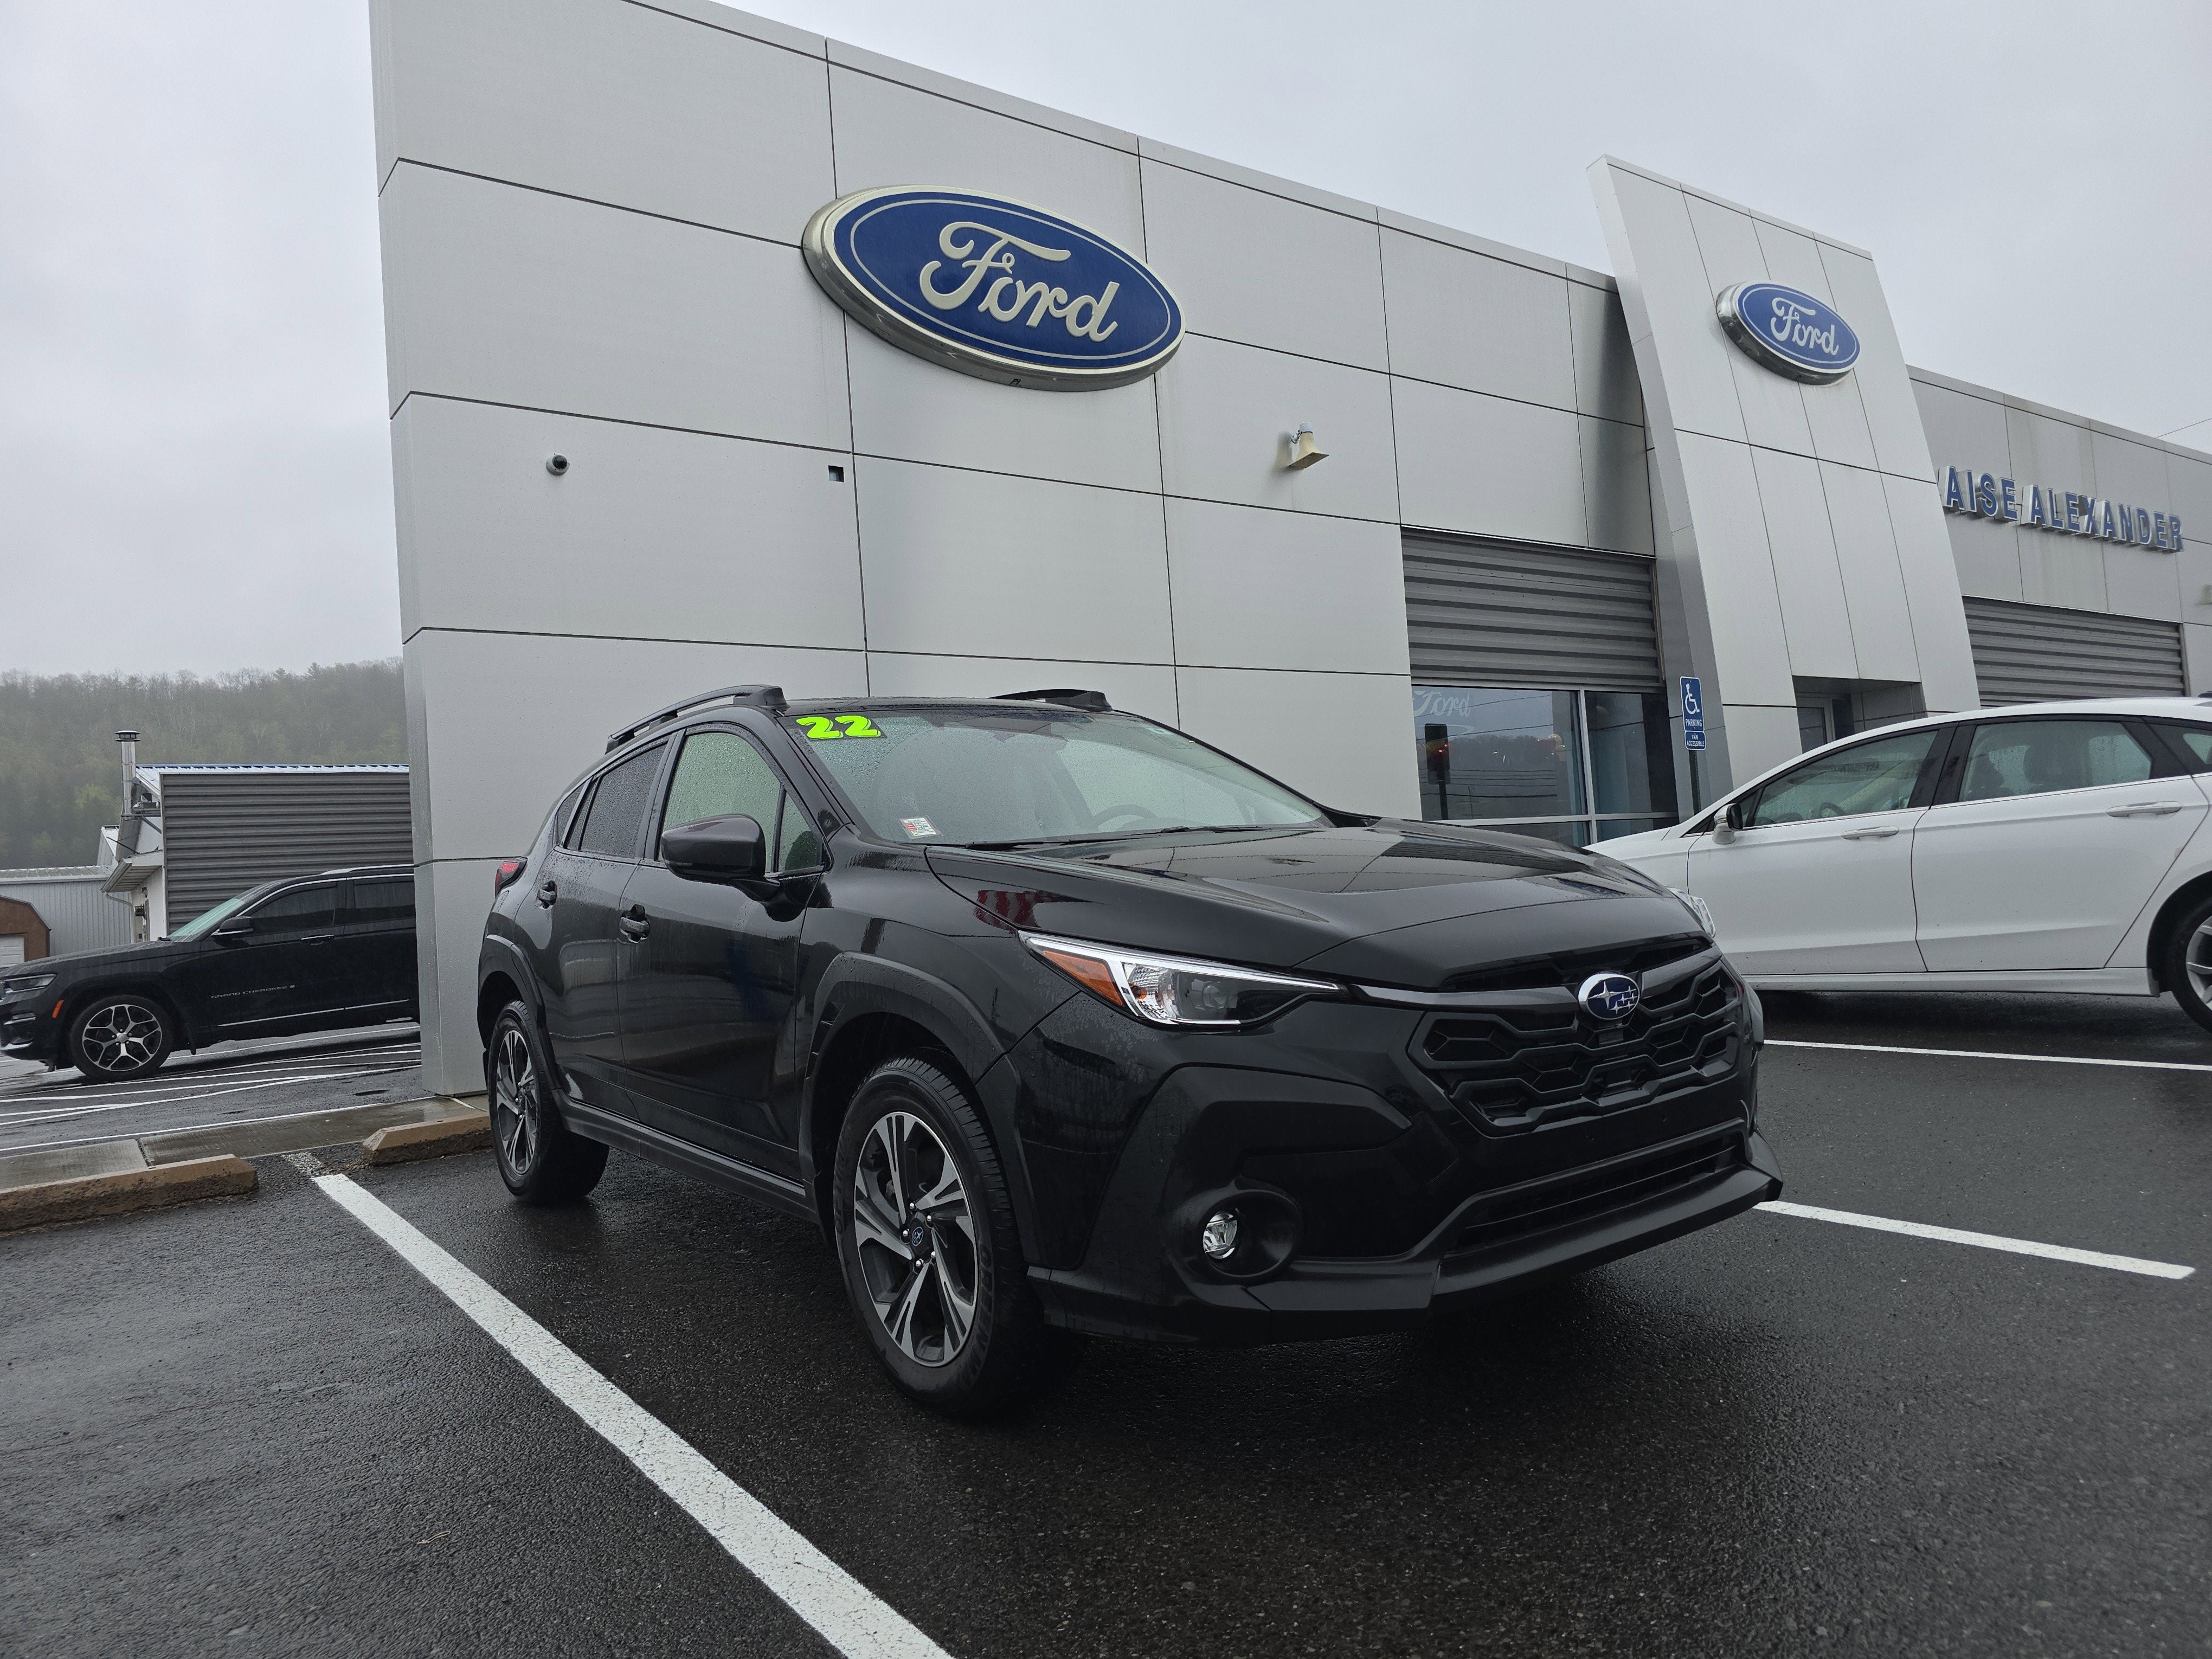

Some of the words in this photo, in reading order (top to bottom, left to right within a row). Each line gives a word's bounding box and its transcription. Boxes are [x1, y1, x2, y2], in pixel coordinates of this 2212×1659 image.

[919, 221, 1118, 342] Ford
[1770, 297, 1839, 356] Ford
[2029, 484, 2184, 552] ALEXANDER
[1412, 691, 1471, 717] Ford
[796, 715, 881, 739] 22
[1686, 718, 1702, 726] PARKING
[242, 985, 287, 994] CHEROKEE
